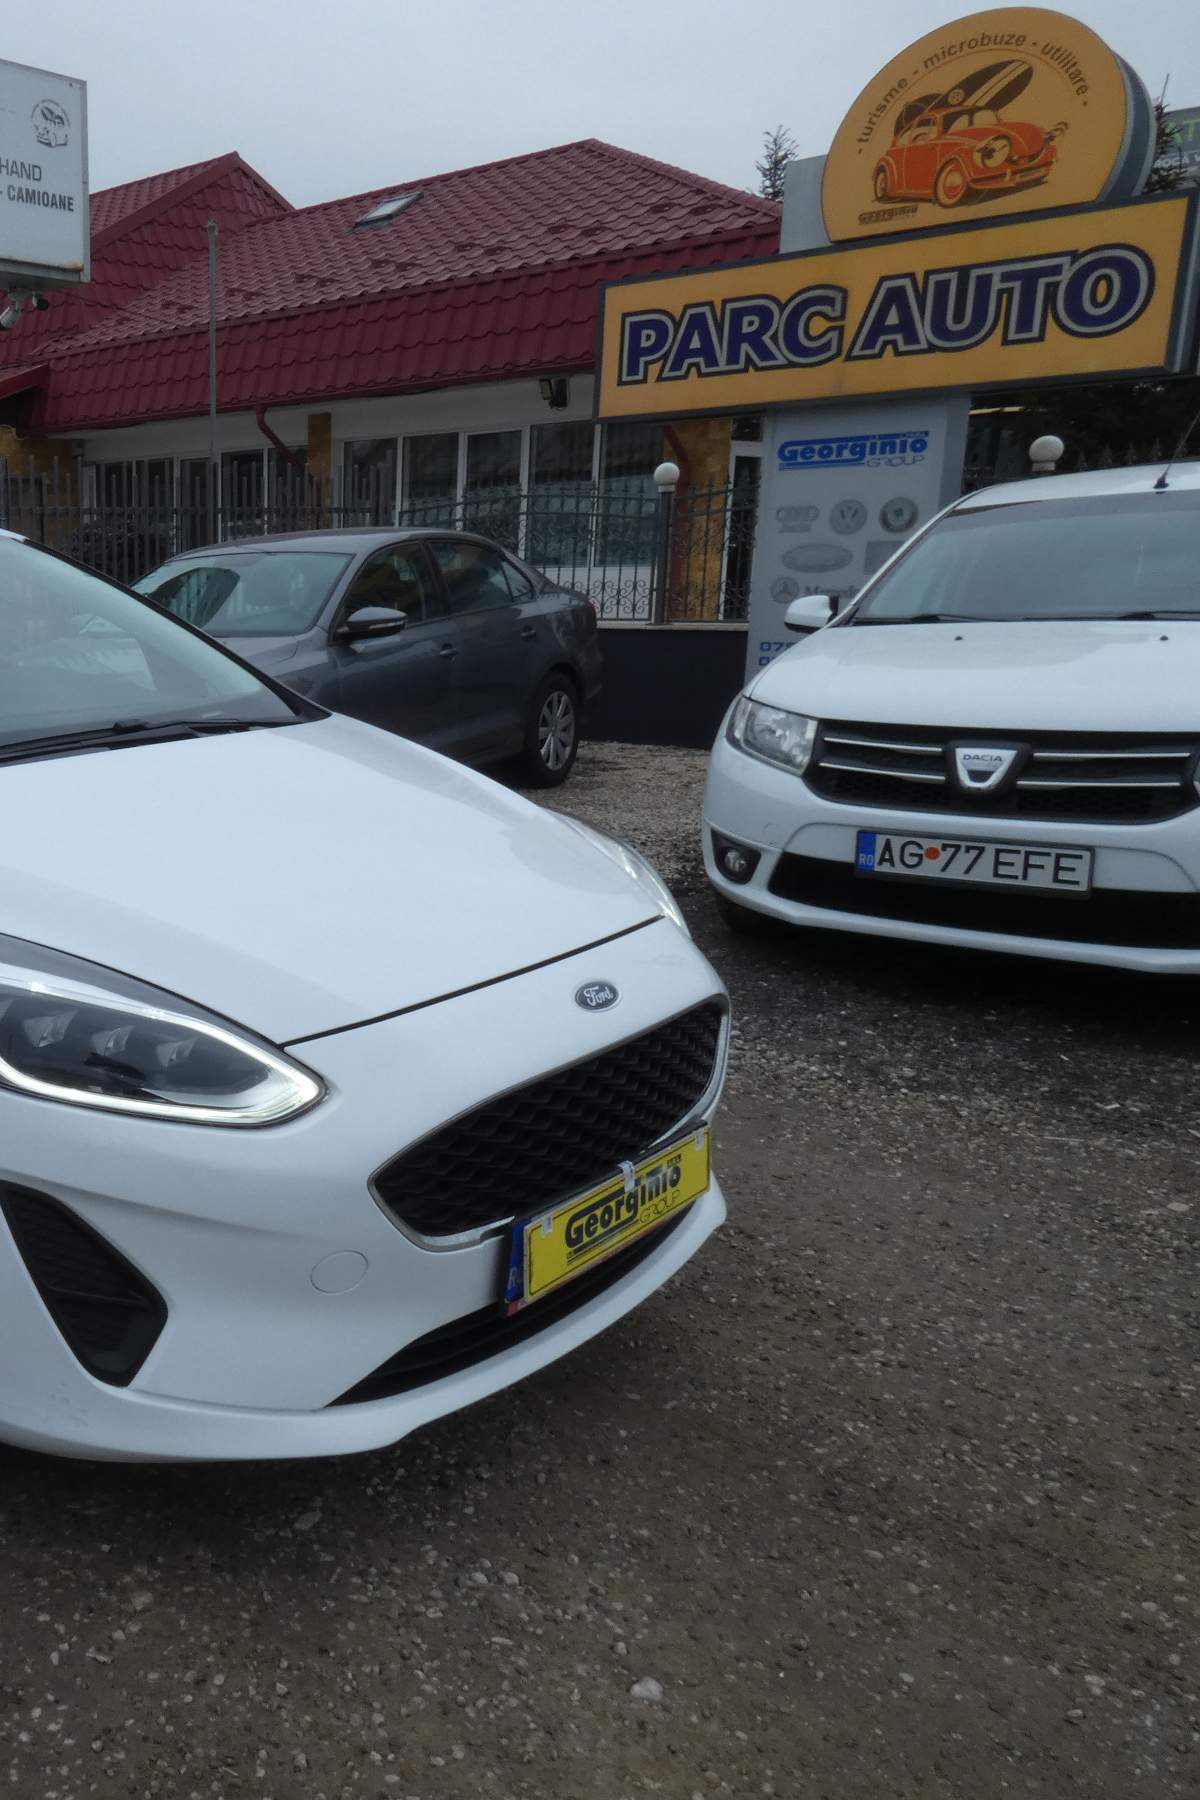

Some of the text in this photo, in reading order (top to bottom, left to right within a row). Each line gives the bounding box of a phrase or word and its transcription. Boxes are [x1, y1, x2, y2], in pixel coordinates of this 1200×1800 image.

[856, 77, 909, 145] turisme
[922, 31, 1027, 70] microbuze
[1040, 40, 1090, 97] utilitare
[6, 184, 75, 213] CAMIOANE
[618, 243, 1156, 387] PARC AUTO
[778, 431, 930, 470] Georginio
[962, 752, 1004, 764] DACIA
[859, 853, 874, 867] RO
[991, 847, 1084, 886] EFE
[583, 984, 615, 1007] Ford
[565, 1163, 682, 1252] Georginio
